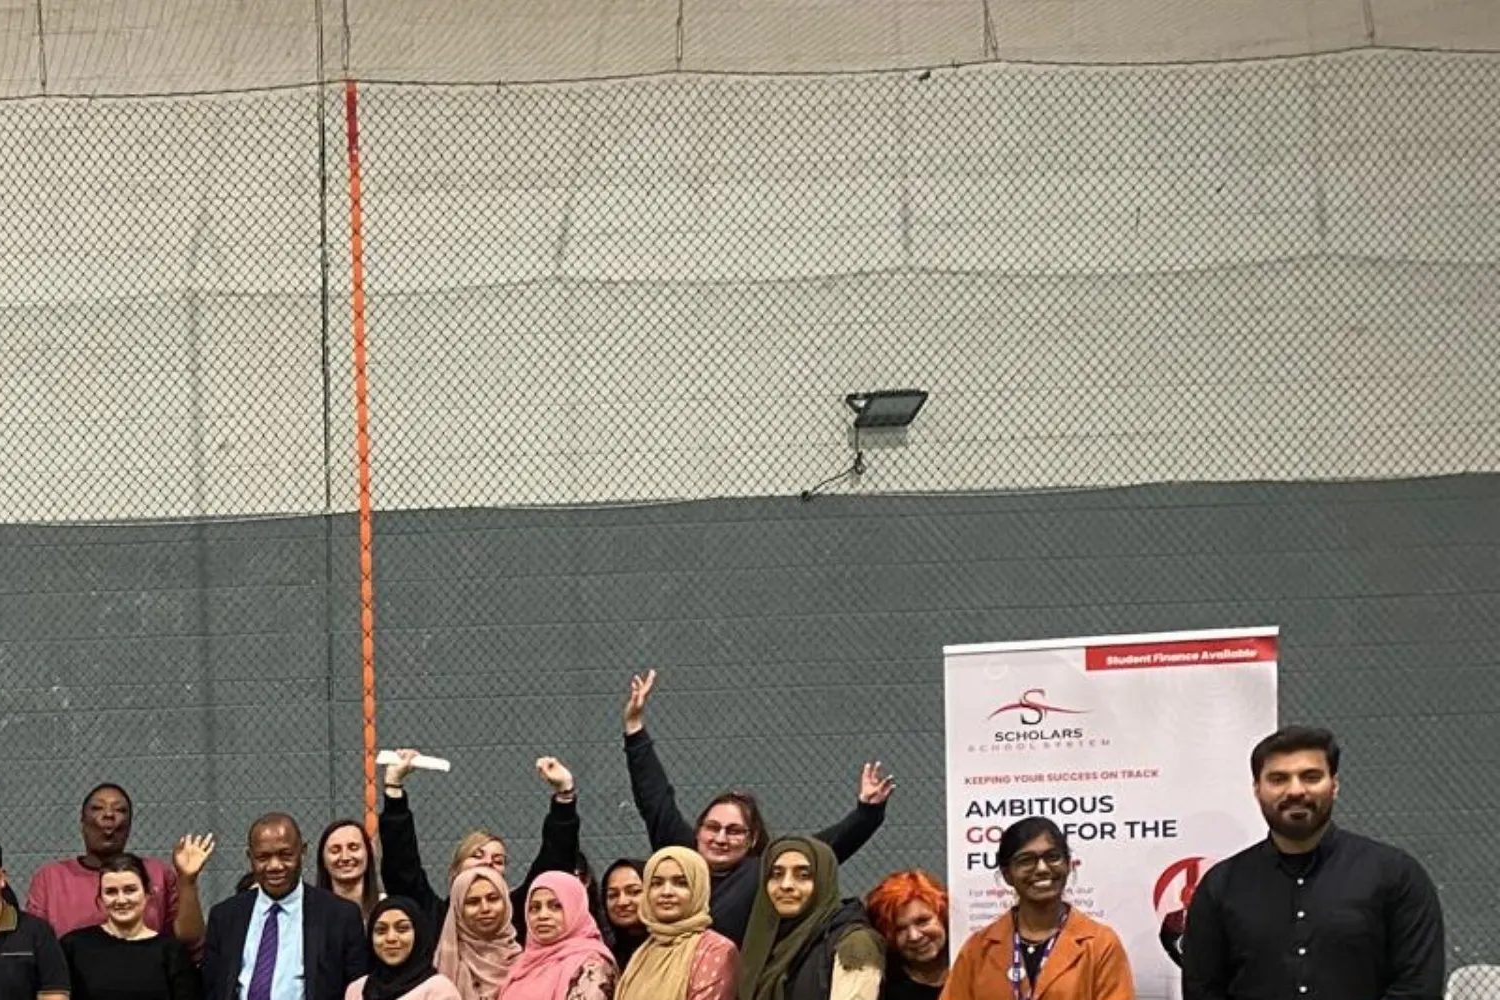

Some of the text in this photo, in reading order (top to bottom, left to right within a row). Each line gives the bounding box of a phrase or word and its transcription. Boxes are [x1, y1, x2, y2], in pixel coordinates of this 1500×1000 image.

[1106, 649, 1258, 666] Student Finance Available
[994, 727, 1084, 743] SCHOLARS
[964, 768, 1160, 786] KEEPING YOUR SUCCESS ON TRACK
[965, 795, 1115, 819] AMBITIOUS
[1063, 819, 1178, 841] FOR THE
